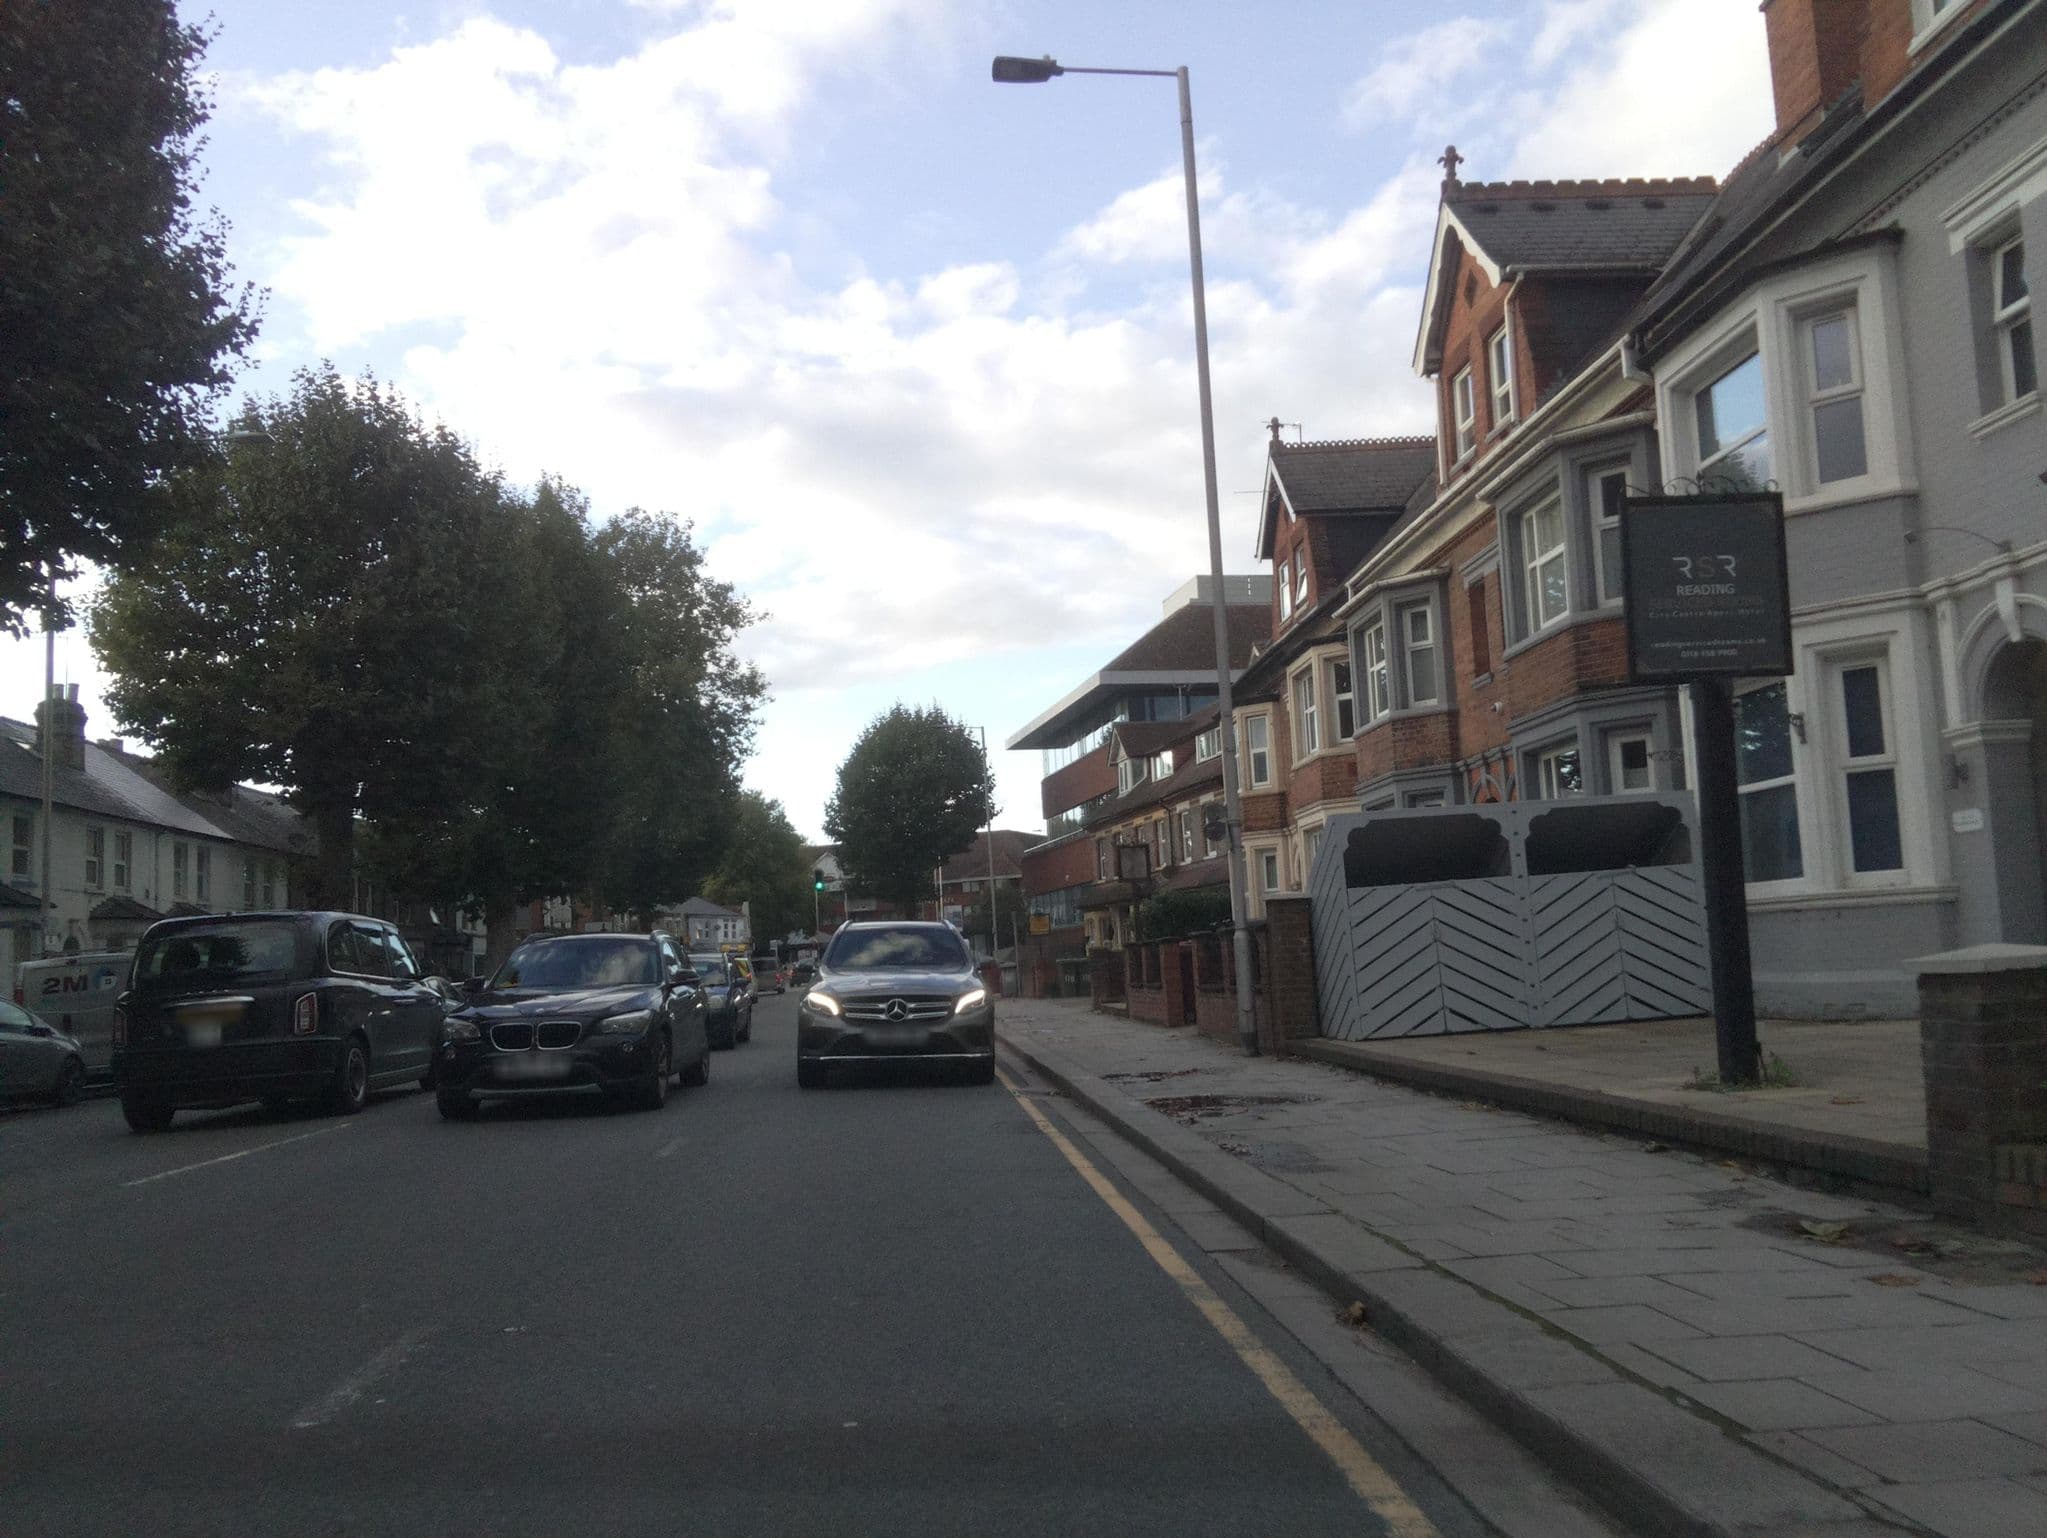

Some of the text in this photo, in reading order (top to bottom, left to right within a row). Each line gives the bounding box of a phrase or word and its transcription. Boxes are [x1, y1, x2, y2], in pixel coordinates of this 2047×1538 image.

[1672, 555, 1737, 579] RSR
[1676, 583, 1736, 597] READING
[42, 975, 88, 994] 2M
